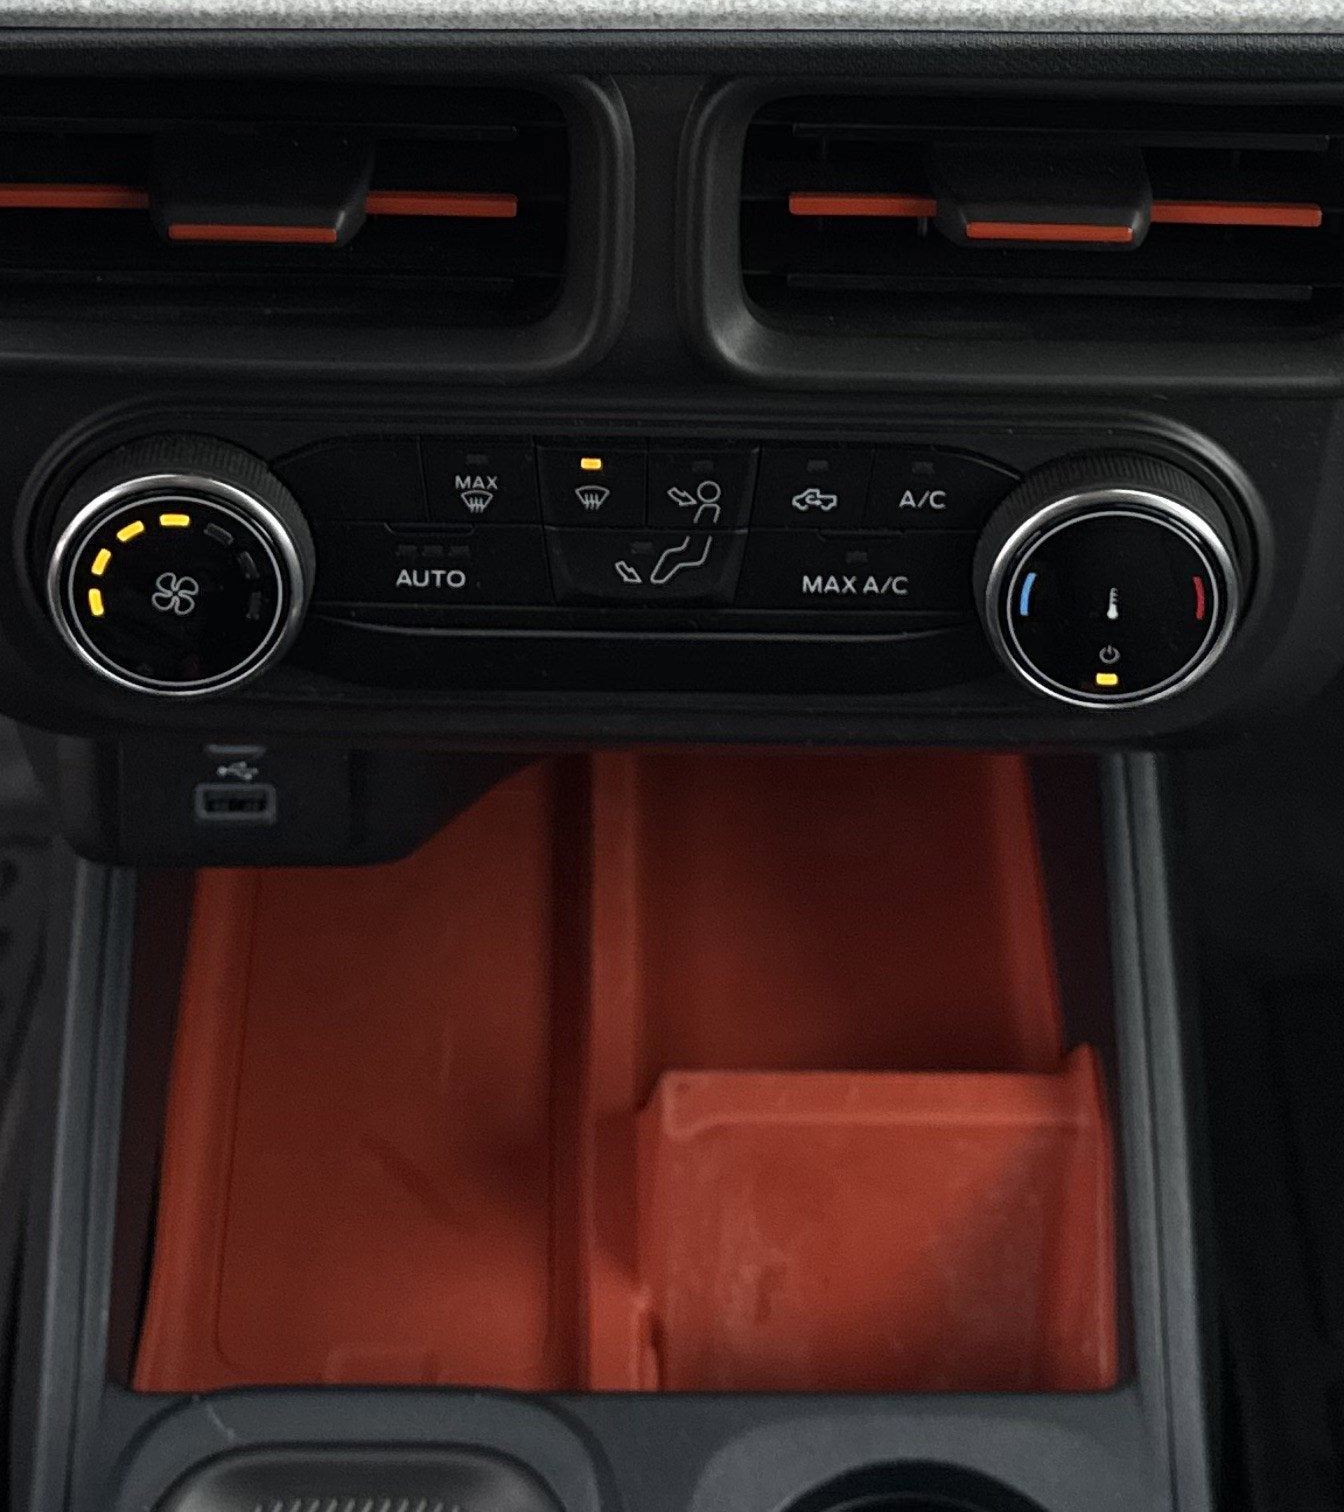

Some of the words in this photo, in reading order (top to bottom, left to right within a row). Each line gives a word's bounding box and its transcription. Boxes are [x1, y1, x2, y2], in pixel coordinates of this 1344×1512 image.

[456, 476, 498, 489] MAX
[899, 491, 947, 509] A/C
[396, 570, 466, 588] AUTO
[802, 576, 857, 594] MAX
[864, 576, 910, 595] A/C
